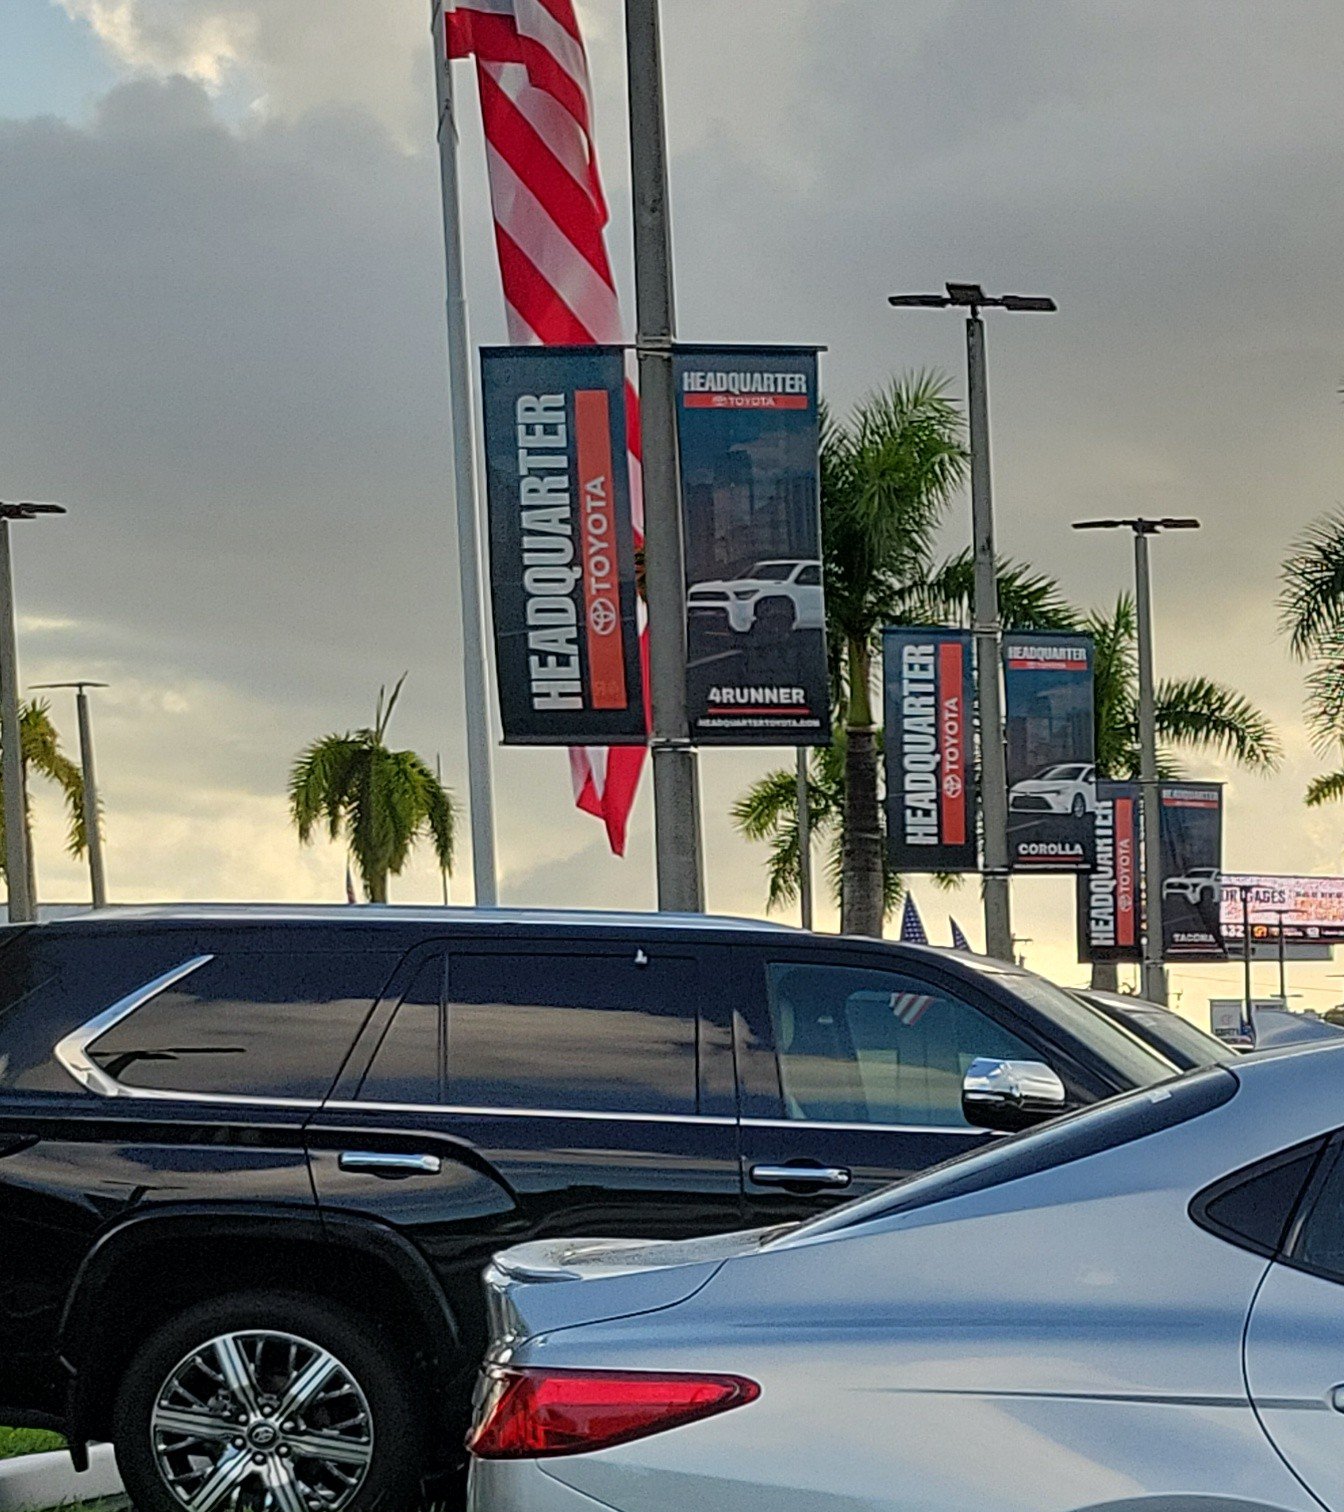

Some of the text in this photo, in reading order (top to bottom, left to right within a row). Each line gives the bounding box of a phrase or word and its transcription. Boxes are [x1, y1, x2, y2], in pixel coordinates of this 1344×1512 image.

[683, 371, 807, 394] HEADQUARTER
[730, 396, 775, 406] TOYOTA
[517, 393, 584, 710] HEADQUARTER
[585, 476, 611, 594] TOYOTA
[1008, 646, 1087, 661] HEADQUARTER
[707, 686, 806, 704] 4RUNNER
[903, 644, 941, 845] HEADQUARTER
[944, 697, 960, 772] TOYOTA
[1018, 843, 1083, 855] COROLLA
[1089, 800, 1117, 946] HEADQUARTER
[1119, 838, 1132, 893] TOYOTA
